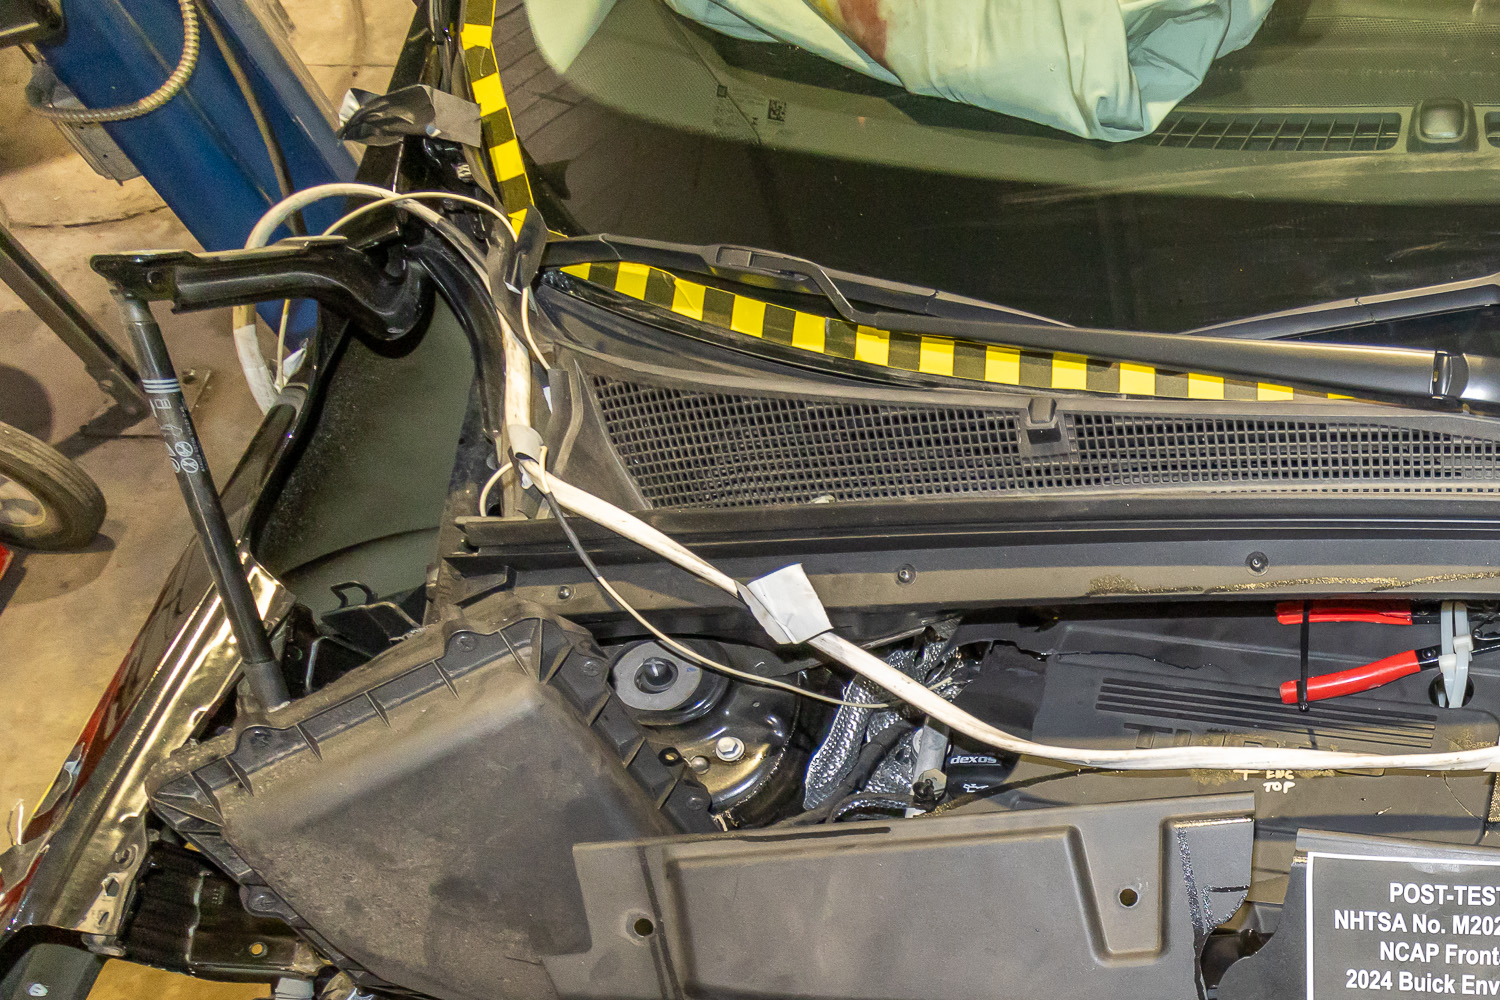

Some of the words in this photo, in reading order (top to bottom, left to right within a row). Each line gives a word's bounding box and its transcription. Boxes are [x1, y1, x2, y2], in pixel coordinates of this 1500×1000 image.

[950, 755, 997, 765] dexos
[1262, 781, 1296, 793] TOP
[1333, 909, 1408, 933] NHTSA
[1412, 914, 1446, 935] No.
[1379, 941, 1440, 963] NCAP
[1345, 969, 1393, 990] 2024
[1398, 971, 1456, 994] Buick
